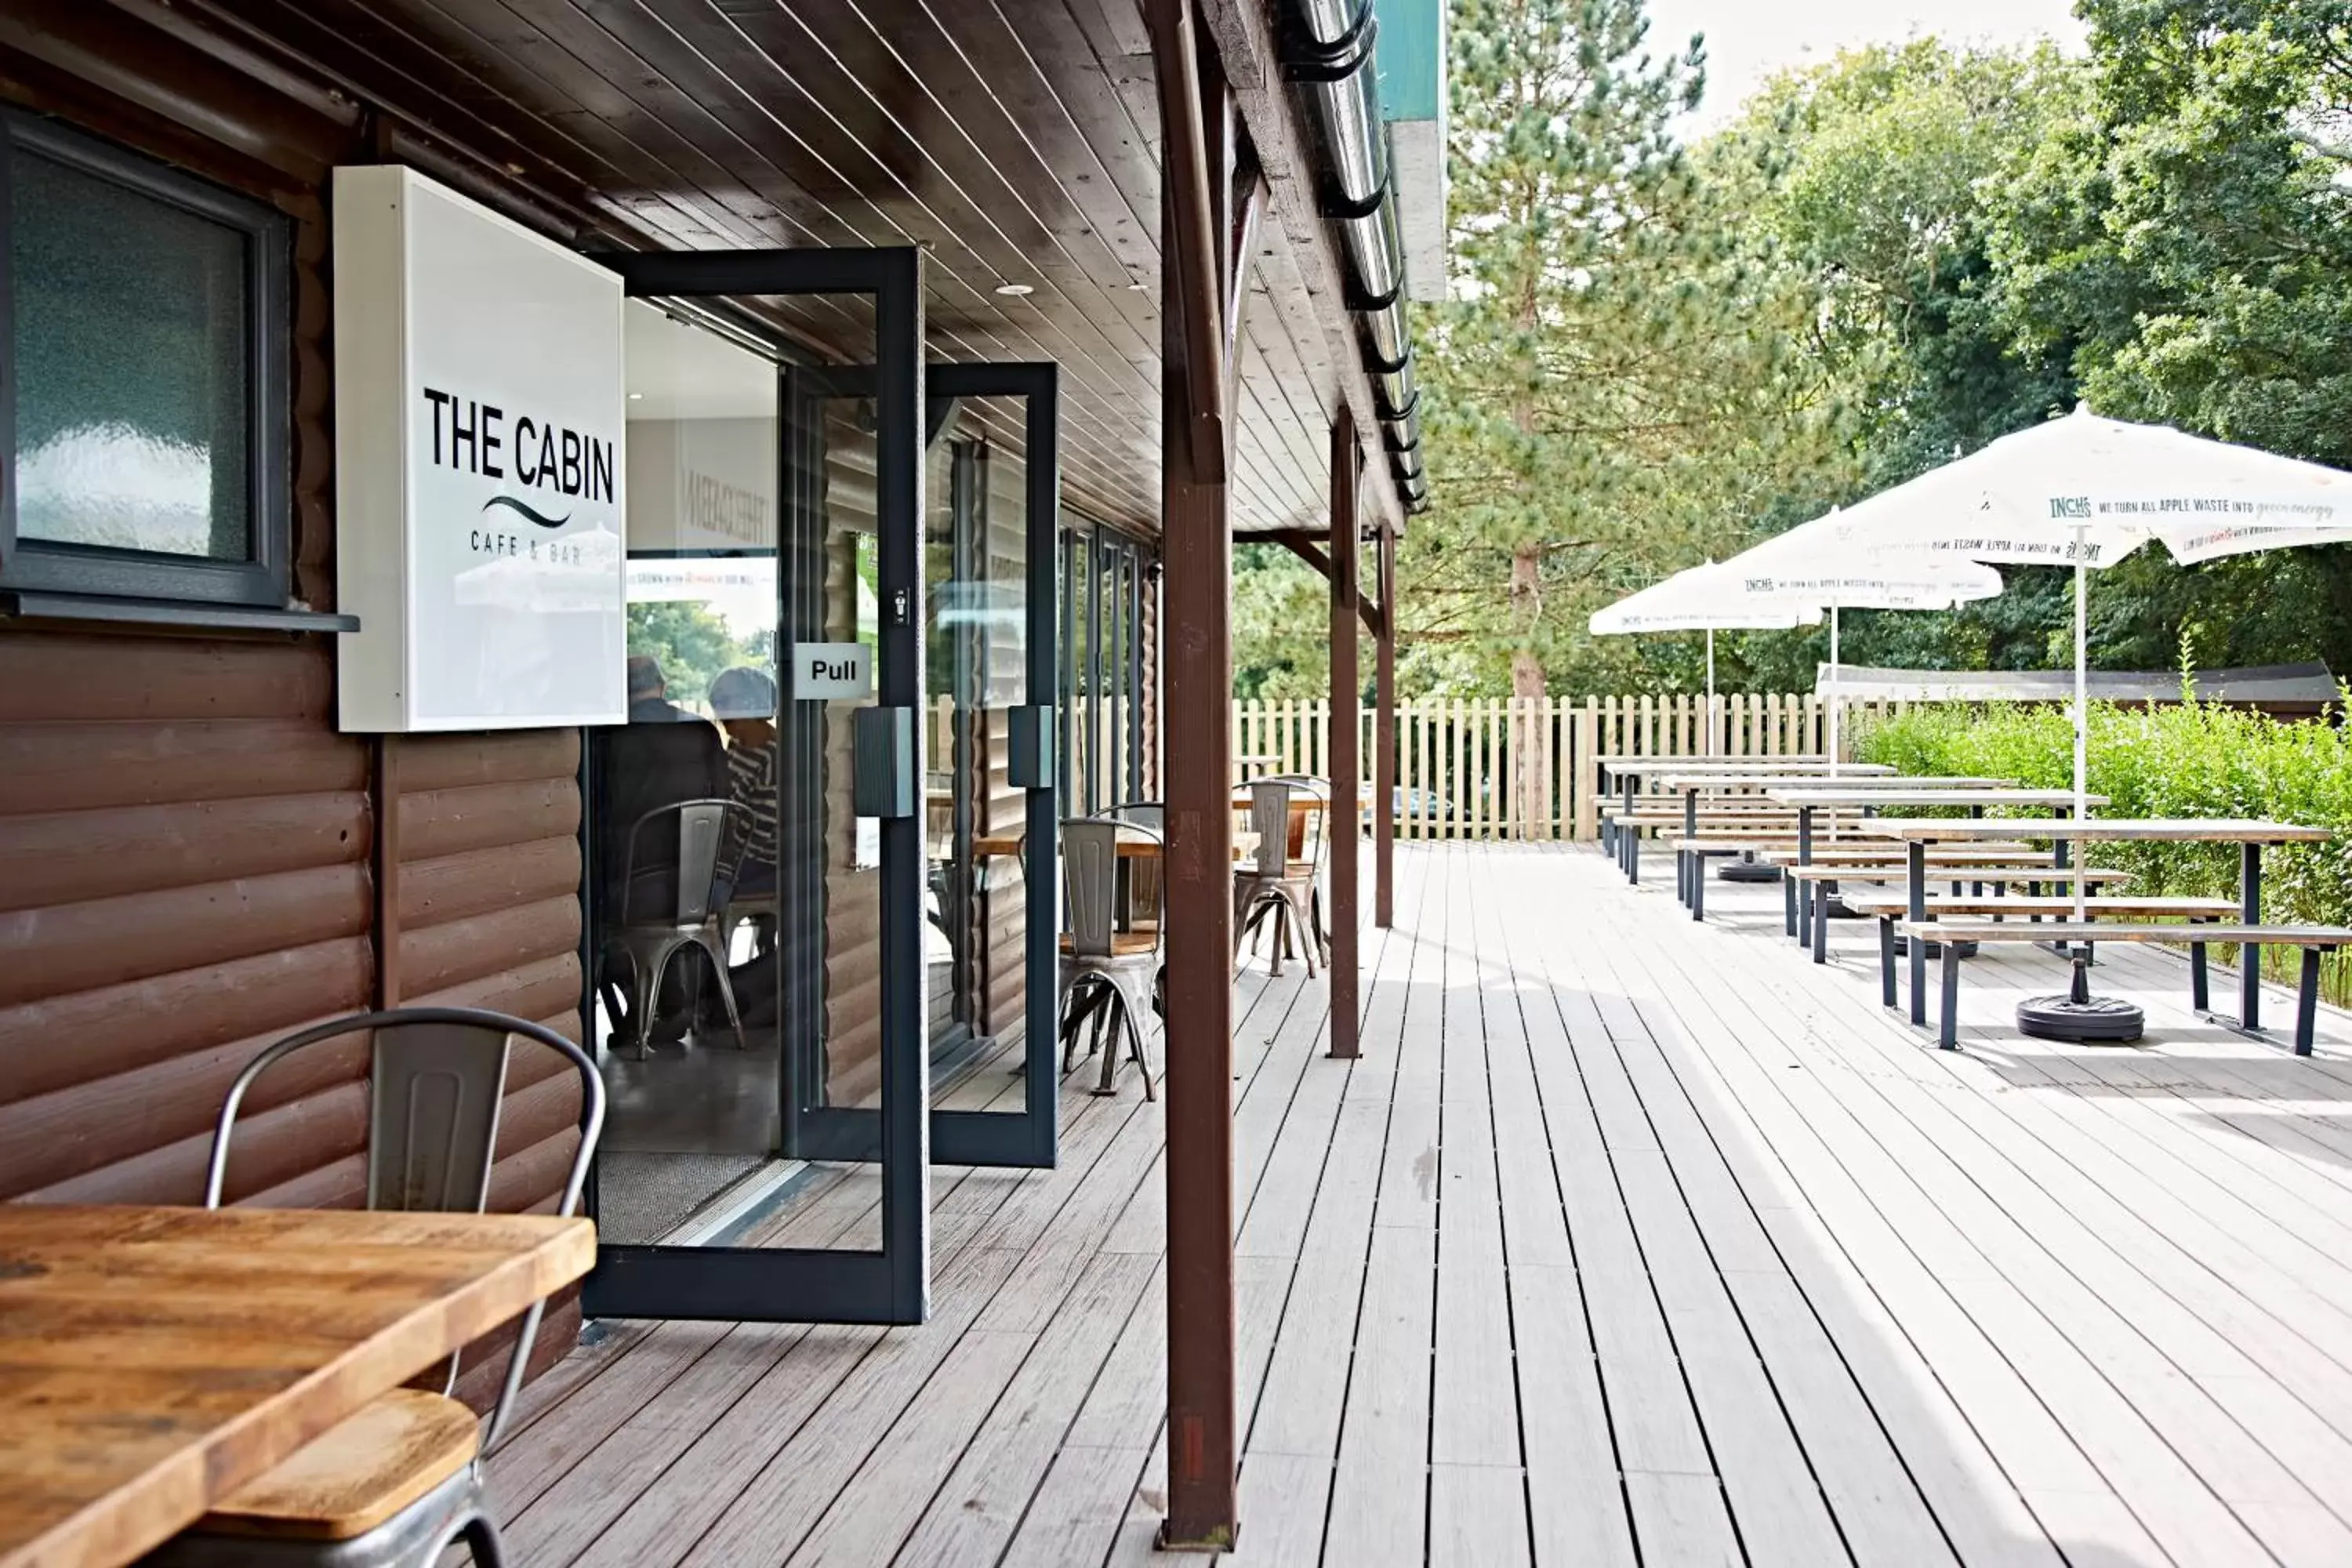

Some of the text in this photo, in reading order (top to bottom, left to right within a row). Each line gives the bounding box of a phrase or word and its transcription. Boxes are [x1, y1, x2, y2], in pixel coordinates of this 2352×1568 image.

[423, 387, 613, 504] THE CABIN
[2099, 502, 2112, 514] WE
[2115, 501, 2138, 514] TURN
[2141, 501, 2156, 513] ALL
[2159, 499, 2189, 512] APPLE
[2194, 499, 2229, 512] WASTE
[2232, 502, 2254, 514] INTO
[470, 530, 582, 565] CAFE & BAR
[811, 660, 855, 681] Pull
